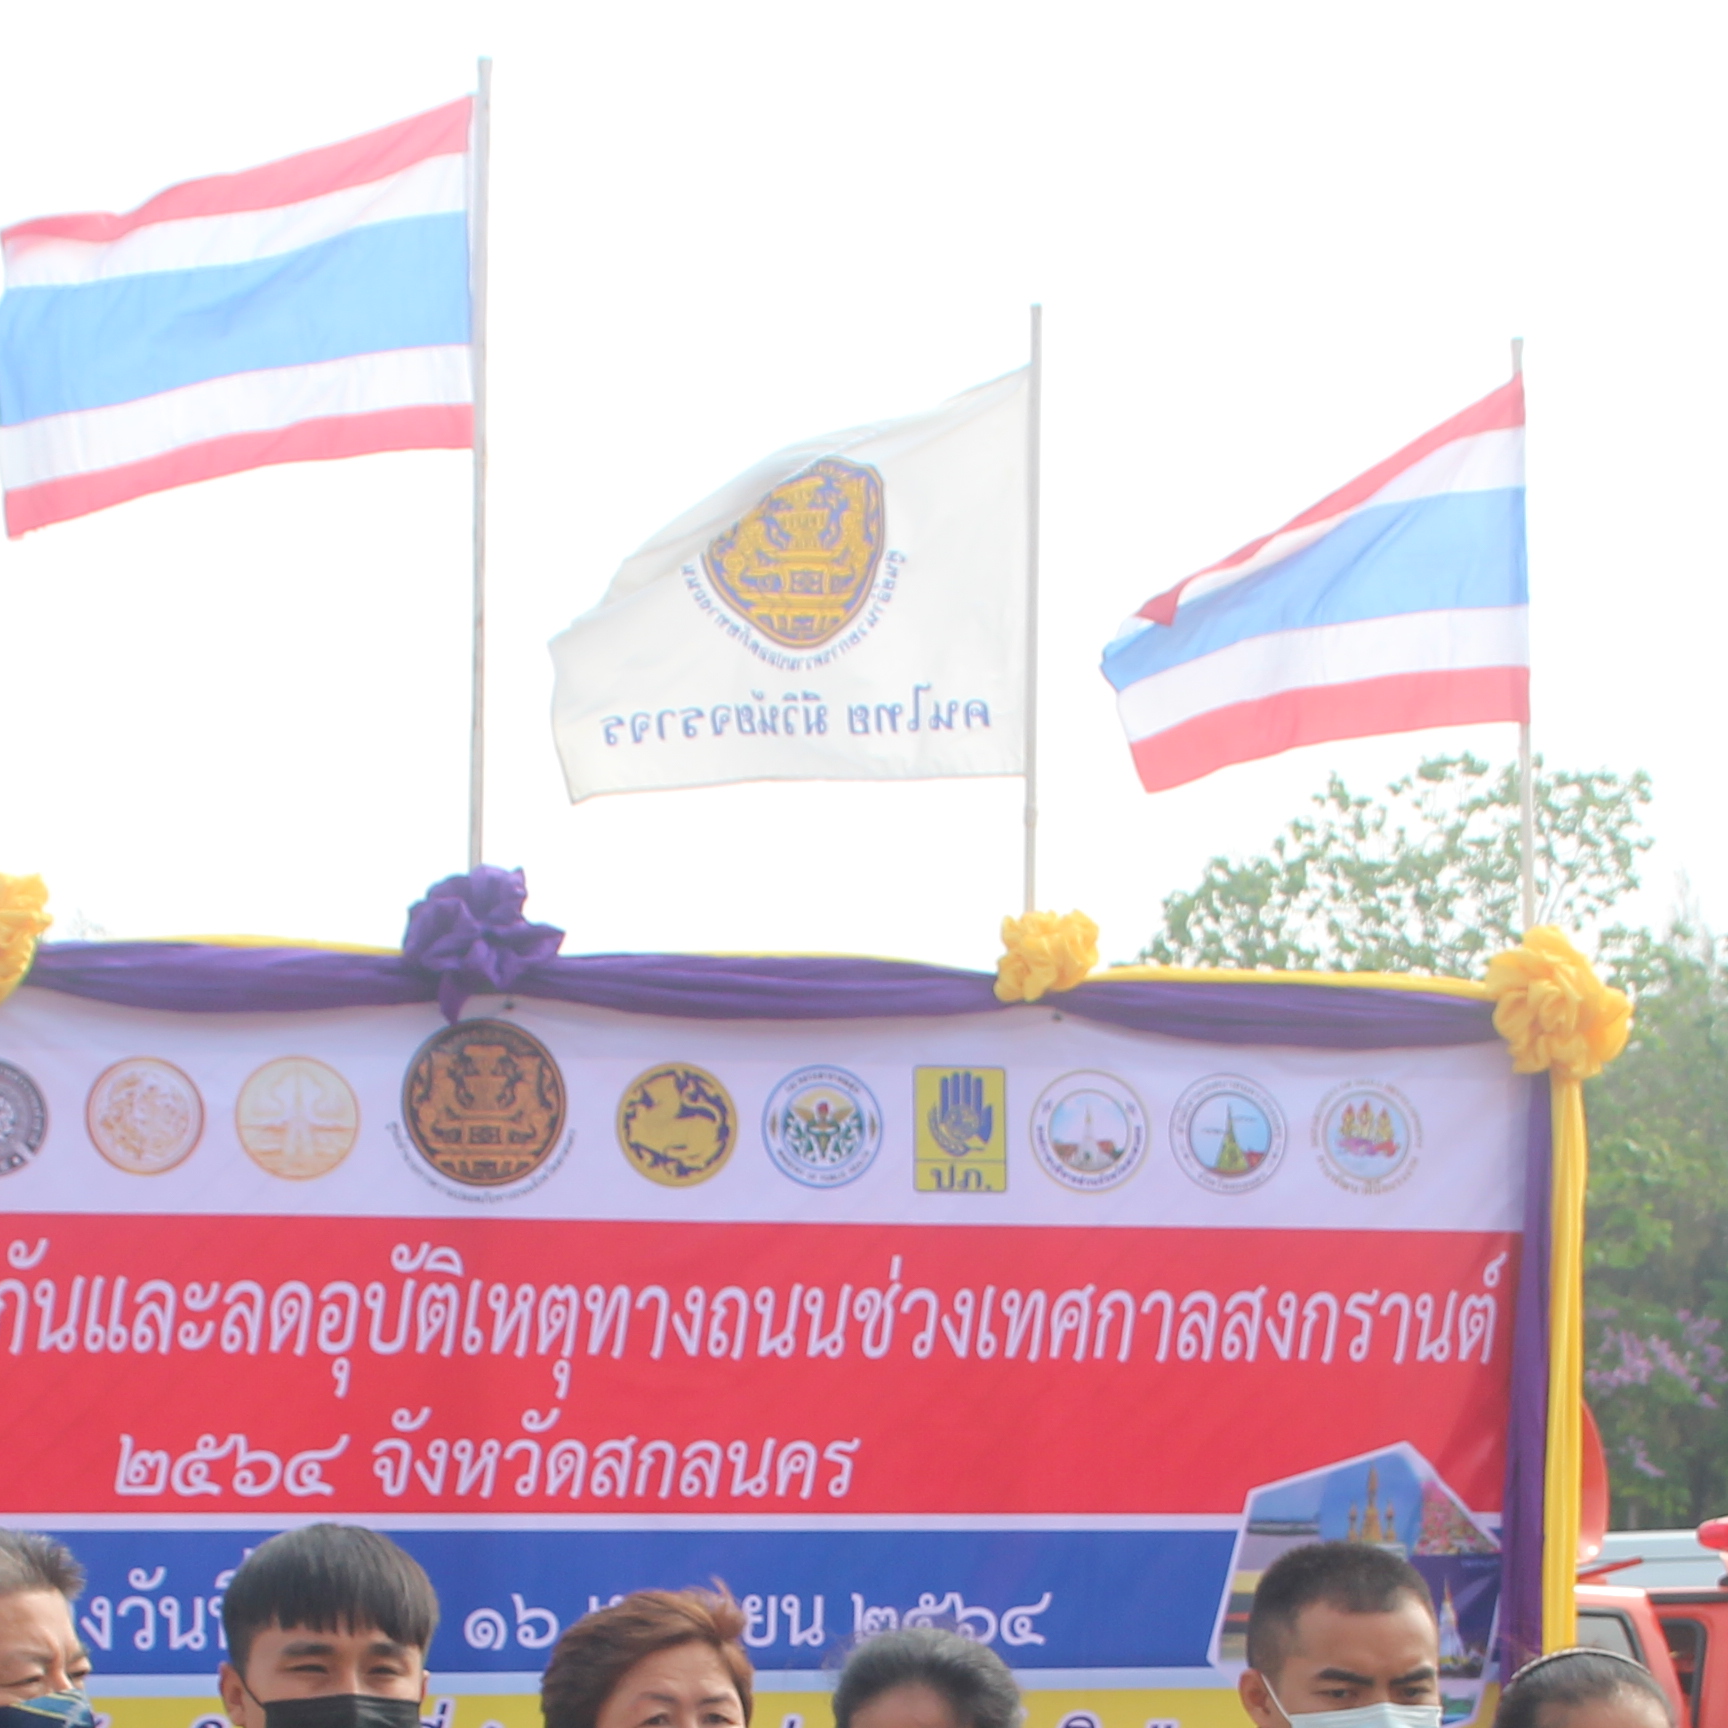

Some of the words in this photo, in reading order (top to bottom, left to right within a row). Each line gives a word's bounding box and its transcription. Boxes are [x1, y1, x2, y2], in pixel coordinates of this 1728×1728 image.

[930, 1163, 993, 1190] ปภ.
[114, 1431, 351, 1498] ๒๕๖๔
[371, 1406, 861, 1500] จังหวัดสกลนคร
